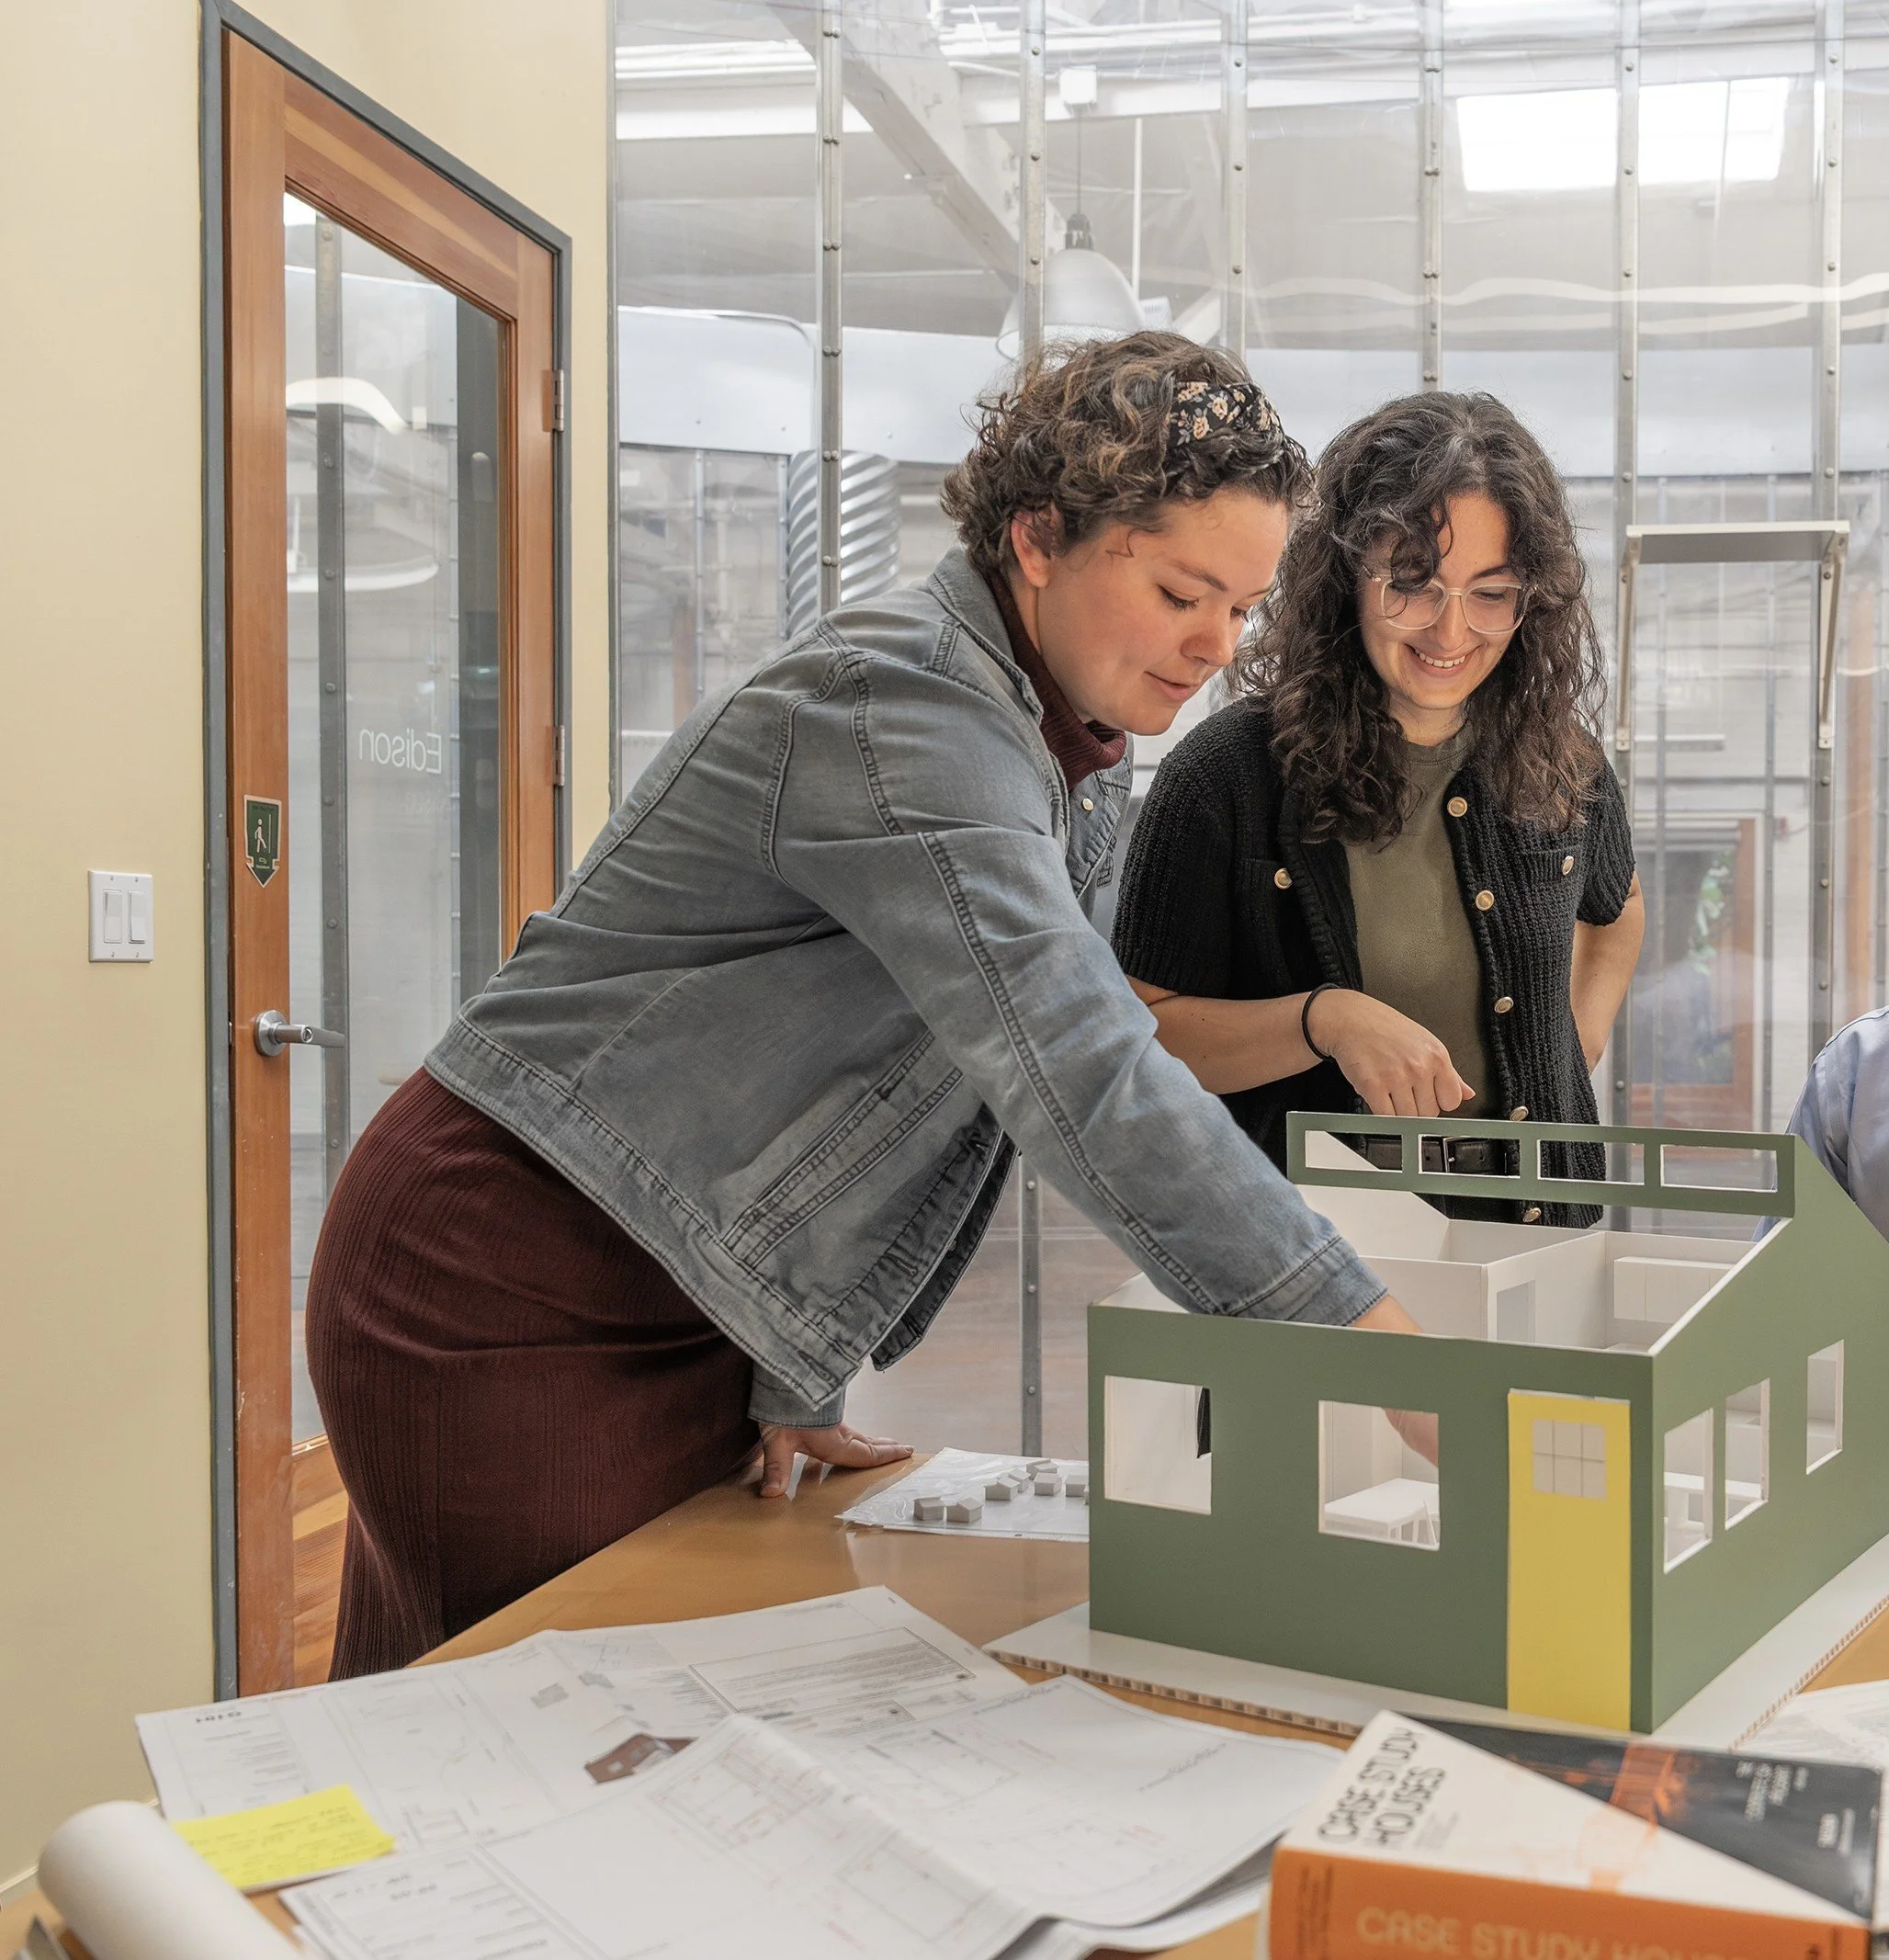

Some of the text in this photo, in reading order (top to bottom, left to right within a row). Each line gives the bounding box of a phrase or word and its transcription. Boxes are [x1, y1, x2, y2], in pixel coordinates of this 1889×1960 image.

[1318, 1726, 1427, 1843] CASE STUDY
[1362, 1765, 1447, 1852] HOUSES
[1357, 1906, 1462, 1956] CASE
[1472, 1921, 1601, 1960] STUDY
